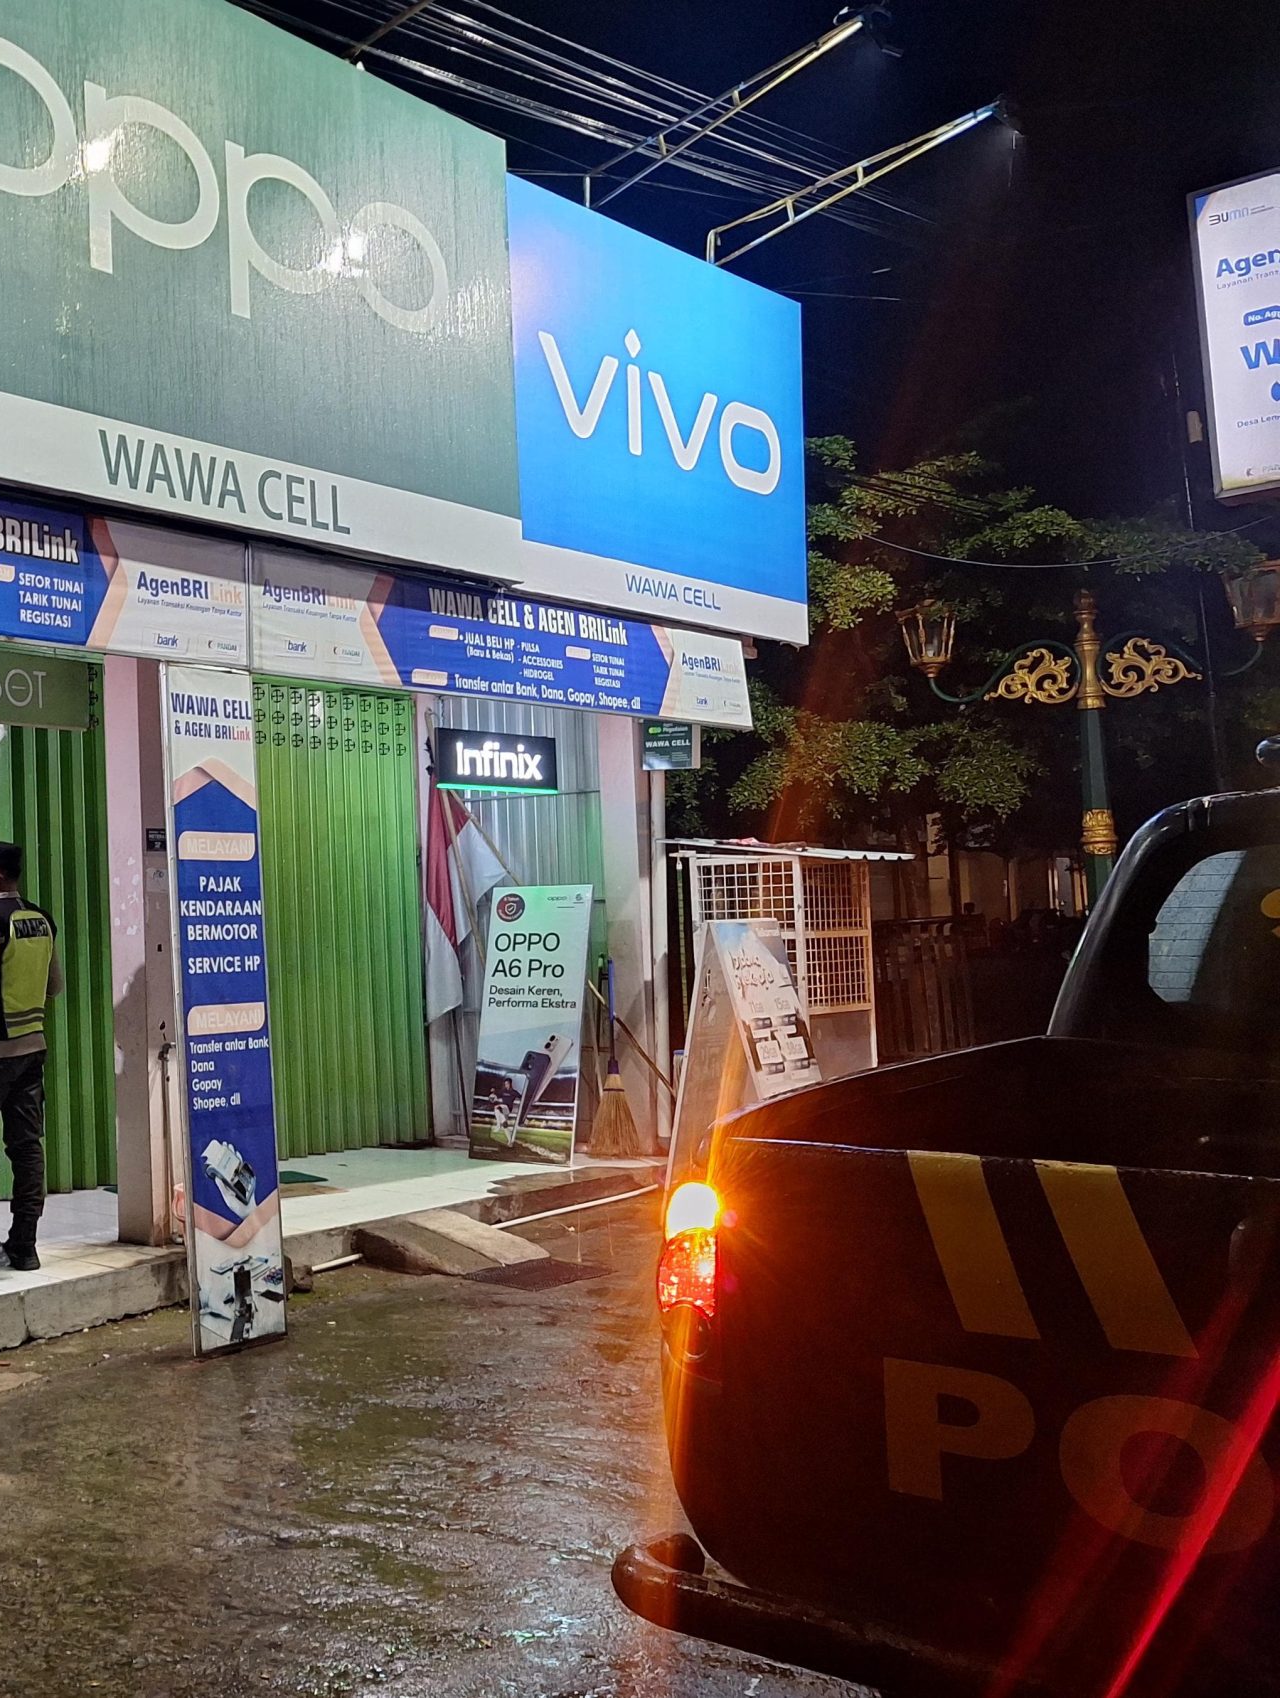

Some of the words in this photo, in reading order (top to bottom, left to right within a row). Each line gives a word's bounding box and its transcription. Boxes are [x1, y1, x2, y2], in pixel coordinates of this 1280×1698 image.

[1217, 276, 1254, 290] Layanan
[538, 328, 781, 495] vivo
[1237, 418, 1259, 428] Desa
[98, 428, 247, 514] WAWA
[257, 469, 351, 535] CELL
[19, 571, 51, 590] SETOR
[52, 575, 84, 595] TUNAI
[625, 573, 678, 602] WAWA
[683, 586, 721, 610] CELL
[19, 590, 49, 608] TARIK
[51, 594, 82, 612] TUNAI
[19, 608, 71, 628] REGISTASI
[429, 588, 484, 621] WAWA
[487, 598, 520, 628] CELL
[523, 604, 535, 629] &
[538, 607, 576, 636] AGEN
[578, 613, 628, 645] BRILink
[464, 632, 485, 647] JUAL
[486, 637, 502, 649] BELI
[504, 638, 515, 650] HP
[521, 641, 540, 653] PULSA
[466, 646, 484, 658] (Baru
[485, 649, 491, 658] &
[492, 650, 514, 663] Bekas)
[523, 655, 563, 670] ACCESSORIES
[524, 668, 555, 681] HIDROGEL
[454, 674, 489, 692] Transfer
[491, 680, 514, 695] antar
[516, 682, 540, 699] Bank,
[541, 685, 566, 703] Dana,
[567, 688, 598, 707] Gopay,
[599, 692, 630, 710] Shopee,
[631, 696, 641, 710] dll
[171, 692, 219, 718] WAWA
[223, 698, 252, 720] CELL
[174, 719, 182, 735] &
[185, 720, 211, 739] AGEN
[215, 724, 251, 741] BRILink
[645, 740, 669, 748] WAWA
[671, 739, 691, 747] CELL
[456, 741, 543, 780] Infinix
[186, 838, 252, 855] MELAYANI
[199, 876, 242, 893] PAJAK
[180, 900, 262, 917] KENDARAAN
[187, 924, 258, 941] BERMOTOR
[495, 932, 560, 952] OPPO
[188, 956, 241, 974] SERVICE
[245, 956, 261, 972] HP
[491, 958, 522, 978] A6
[527, 958, 565, 978] Pro
[489, 985, 526, 996] Desain
[527, 985, 563, 997] Keren,
[488, 997, 540, 1009] Performa
[541, 998, 577, 1009] Ekstra
[196, 1009, 261, 1029] MELAYANI
[190, 1040, 223, 1055] Transfer
[224, 1038, 247, 1051] antar
[248, 1036, 269, 1049] Bank
[191, 1060, 215, 1073] Dana
[192, 1078, 222, 1092] Gopay
[193, 1096, 229, 1111] Shopee,
[230, 1092, 241, 1106] dll
